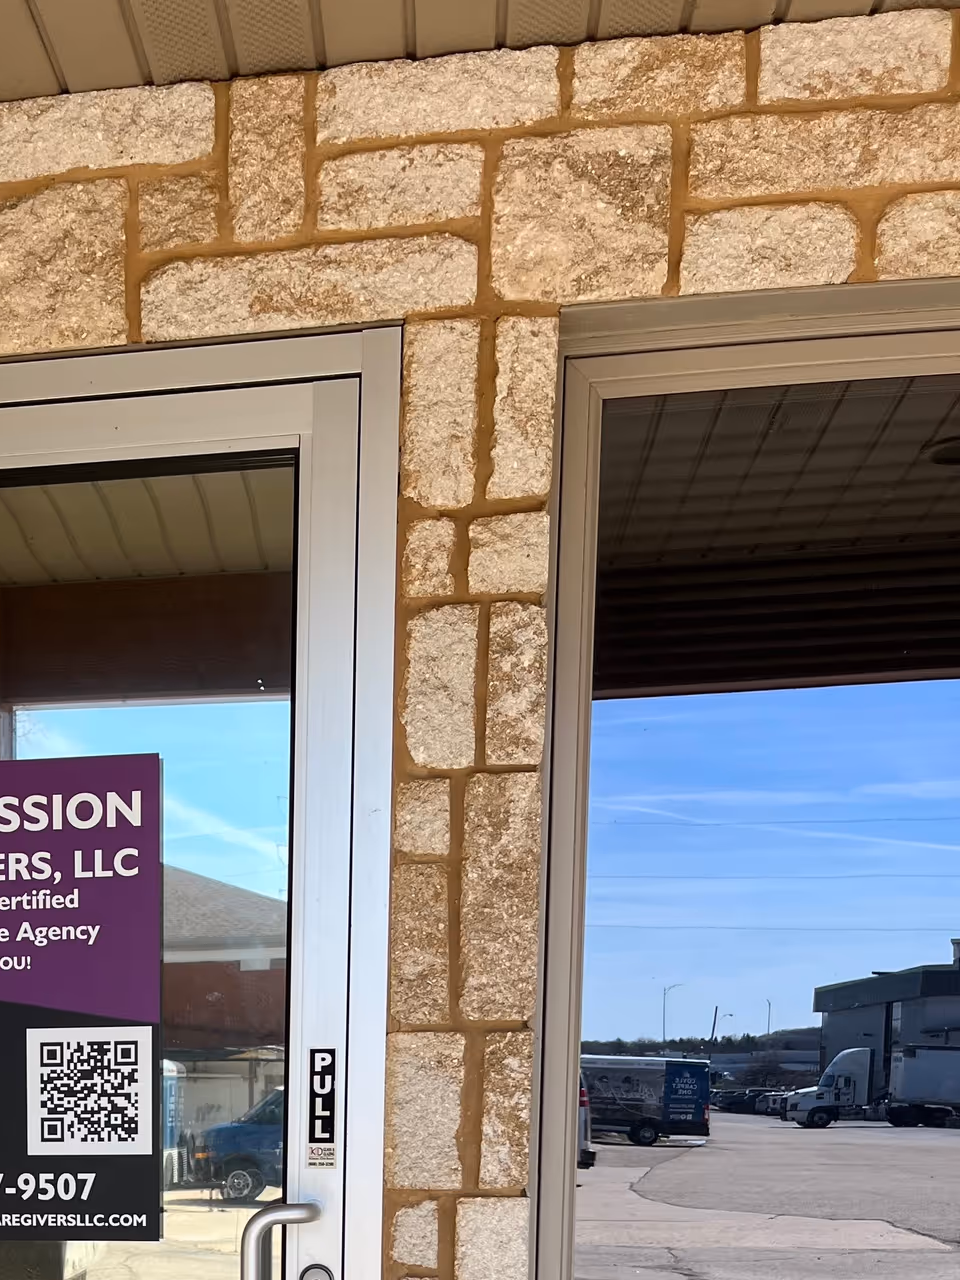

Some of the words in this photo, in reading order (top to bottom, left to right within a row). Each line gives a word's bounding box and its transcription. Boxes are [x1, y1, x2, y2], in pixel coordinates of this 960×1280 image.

[73, 847, 140, 879] LLC
[15, 921, 101, 947] Agency
[313, 1052, 332, 1139] PULL
